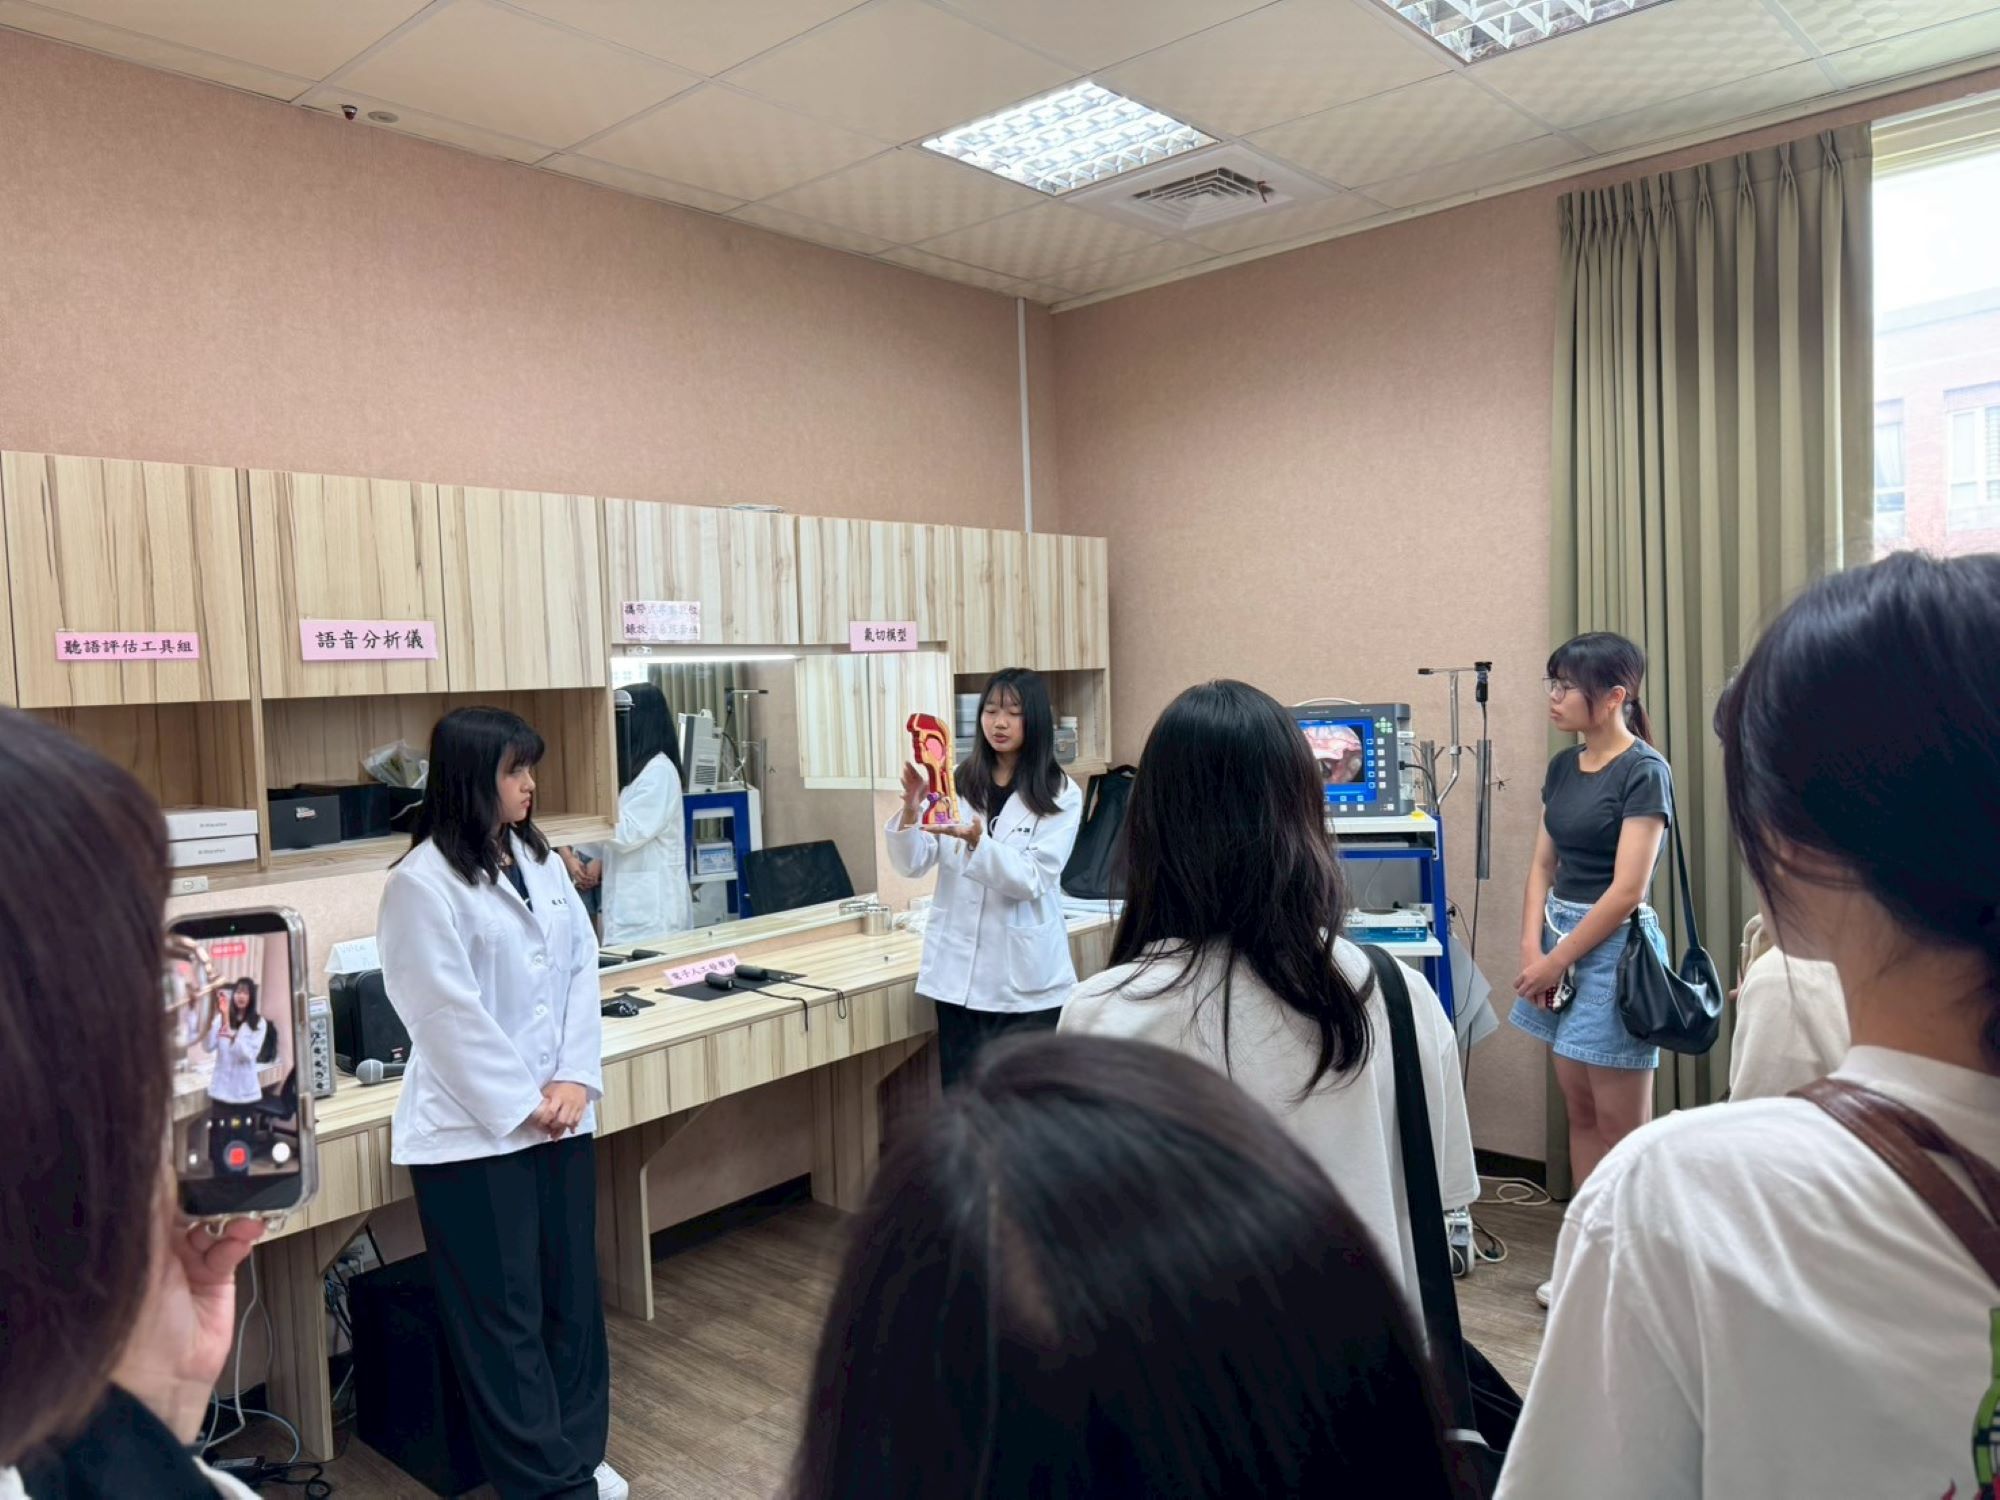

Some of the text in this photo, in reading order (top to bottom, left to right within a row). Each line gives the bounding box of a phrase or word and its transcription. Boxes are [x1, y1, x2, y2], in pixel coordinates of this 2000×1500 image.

[315, 628, 424, 650] 語音分析儀
[864, 627, 907, 642] 氣切模型
[64, 639, 193, 655] 聽語評估工具組
